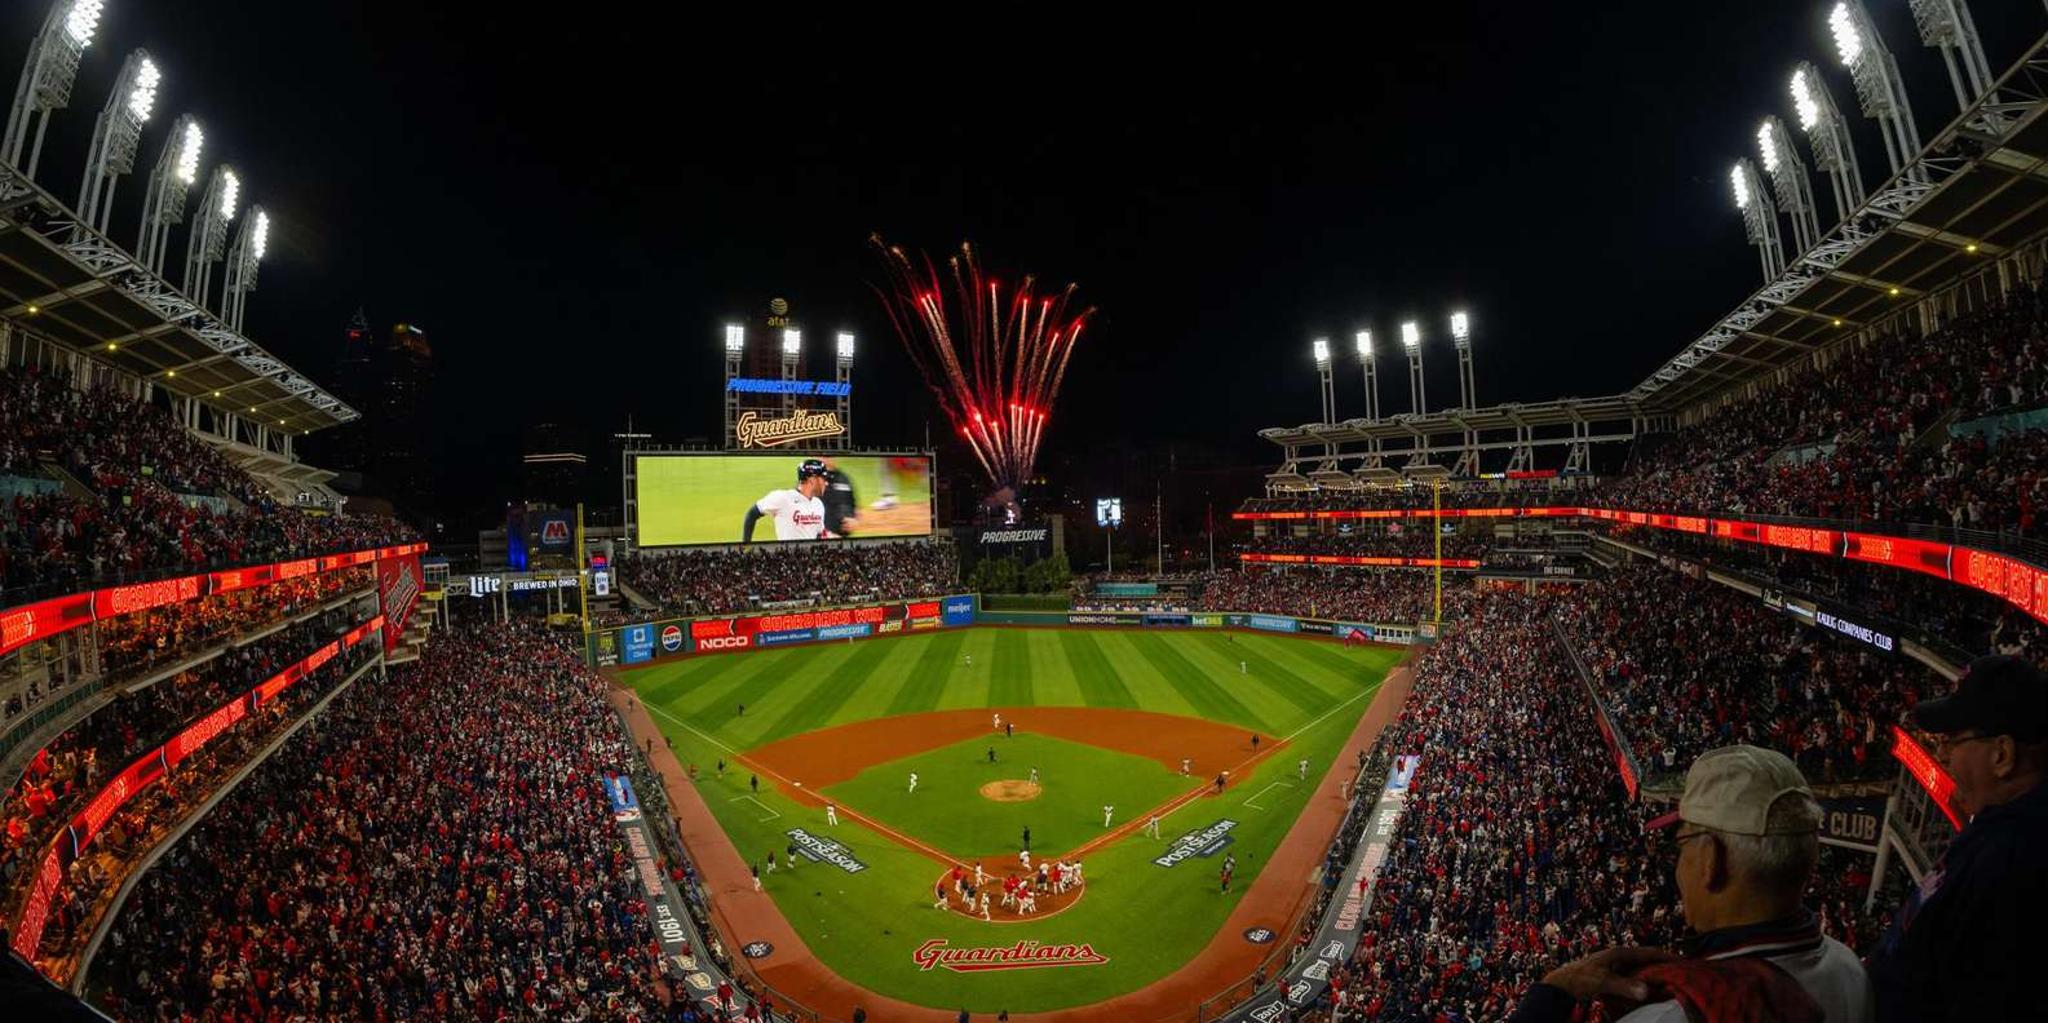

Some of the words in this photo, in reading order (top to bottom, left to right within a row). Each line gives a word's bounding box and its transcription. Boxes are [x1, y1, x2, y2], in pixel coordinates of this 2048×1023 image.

[727, 378, 814, 394] PROGRESSIVE
[815, 382, 851, 395] FIELD
[737, 409, 844, 448] Guardians
[981, 529, 1047, 544] PROGRESSIVE
[469, 576, 500, 598] Lite
[513, 580, 548, 591] BREWED
[548, 579, 558, 588] IN
[558, 578, 578, 588] OHIO
[760, 610, 851, 632] GUARDIANS
[854, 607, 883, 624] WIN
[948, 602, 972, 615] meijer
[701, 636, 748, 648] NOCO
[1874, 632, 1893, 651] CLUB
[1830, 811, 1877, 840] CLUB
[787, 828, 865, 873] POSTSEASON
[1156, 820, 1237, 867] POSTSEASON
[657, 917, 686, 943] 1901
[913, 938, 1111, 973] Guardians
